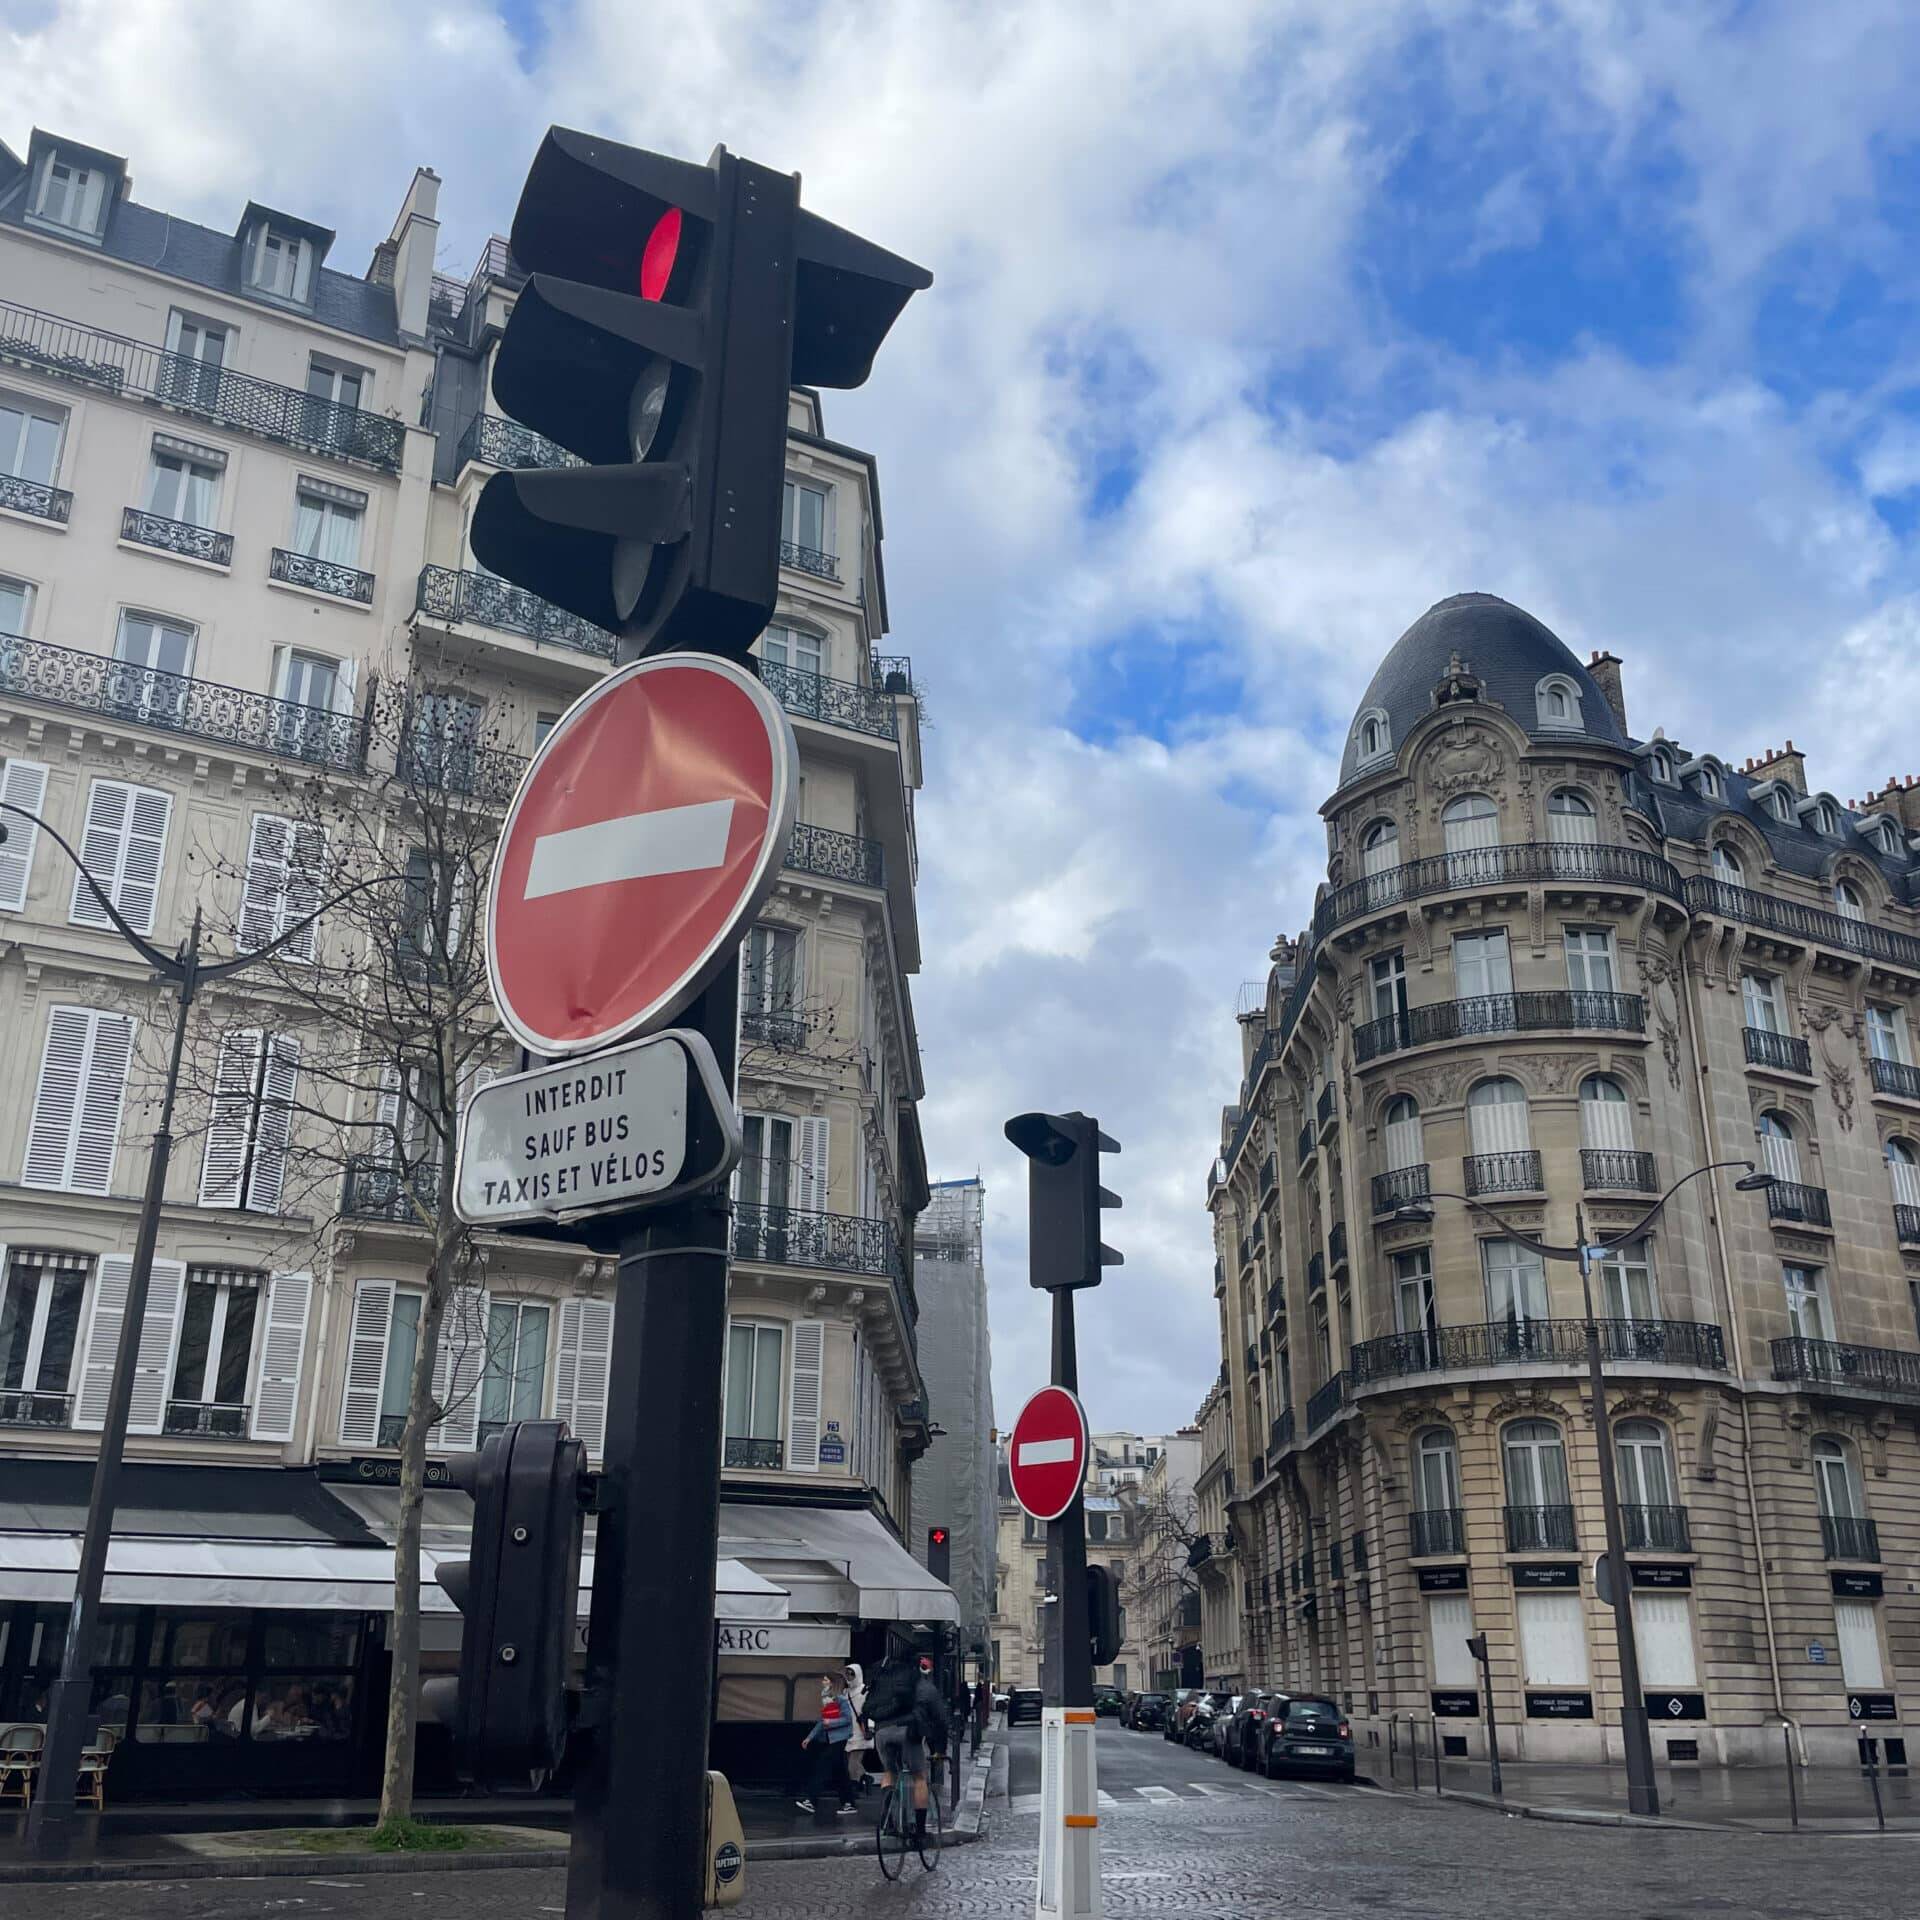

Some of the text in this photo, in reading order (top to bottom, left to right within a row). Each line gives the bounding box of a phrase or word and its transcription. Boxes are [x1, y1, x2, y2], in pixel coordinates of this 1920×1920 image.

[525, 1069, 626, 1117] INTERDIT
[525, 1114, 629, 1160] SAUF BUS
[484, 1149, 665, 1206] TAXIS ET VÉLOS
[718, 1629, 770, 1650] ARC
